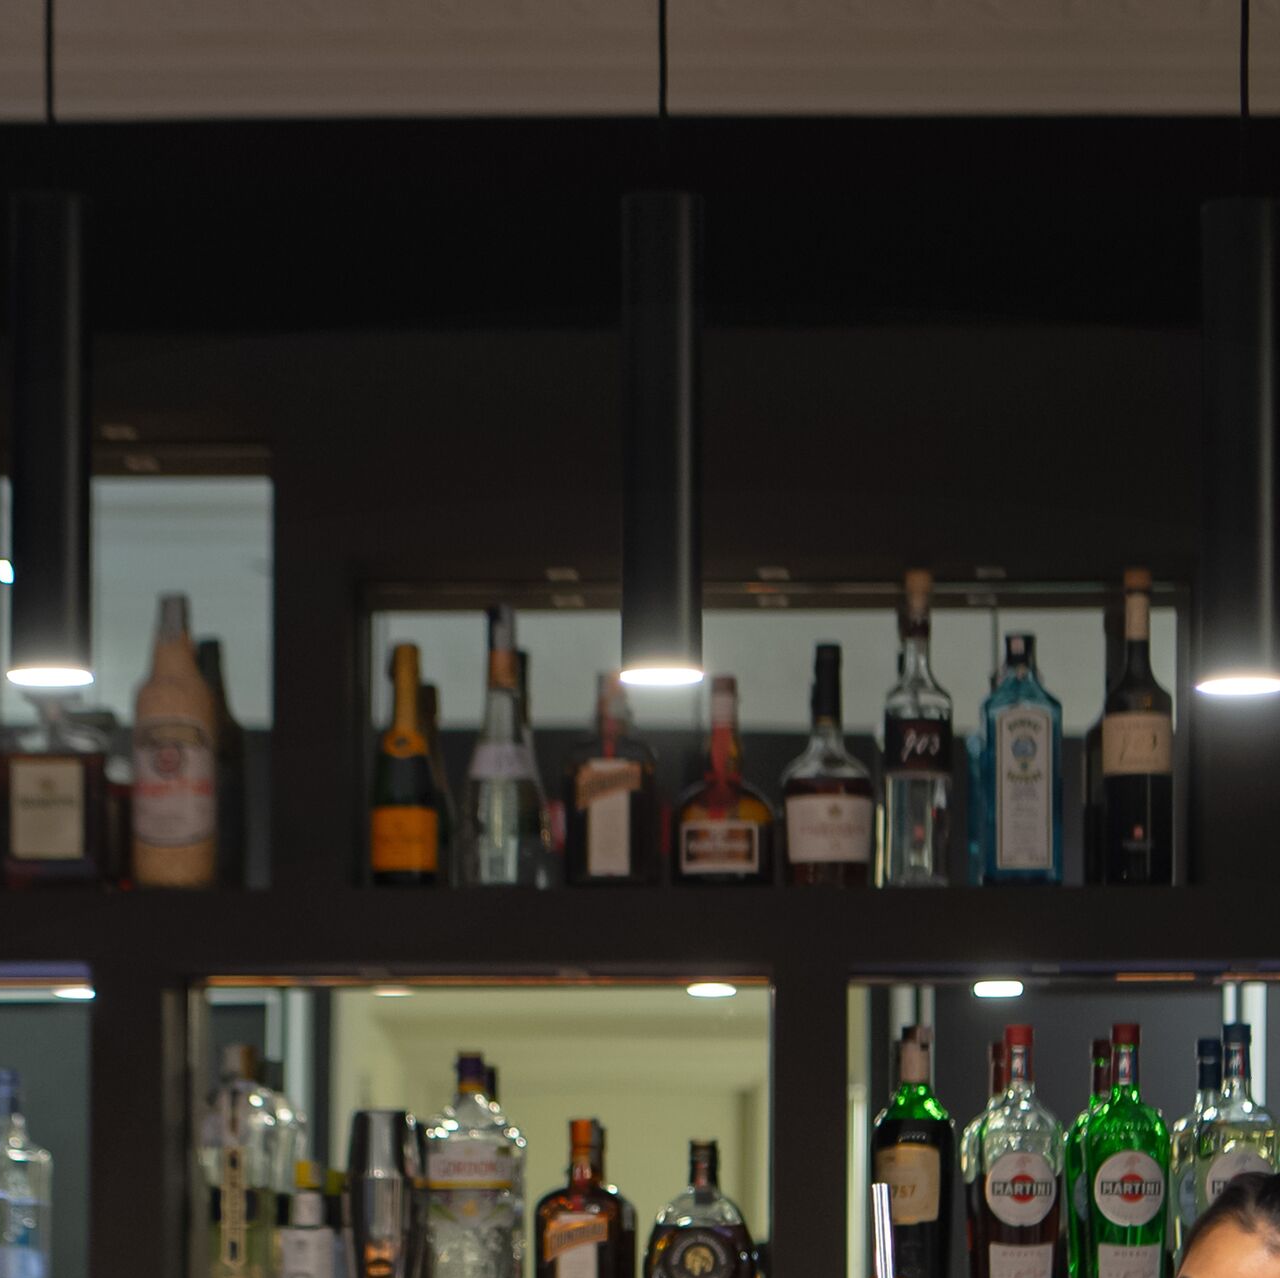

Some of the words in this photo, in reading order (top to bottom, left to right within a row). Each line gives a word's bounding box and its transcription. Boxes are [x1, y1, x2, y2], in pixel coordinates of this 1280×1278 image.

[890, 1184, 917, 1199] 757
[993, 1182, 1052, 1196] MARTINI
[1101, 1181, 1160, 1195] MARTINI
